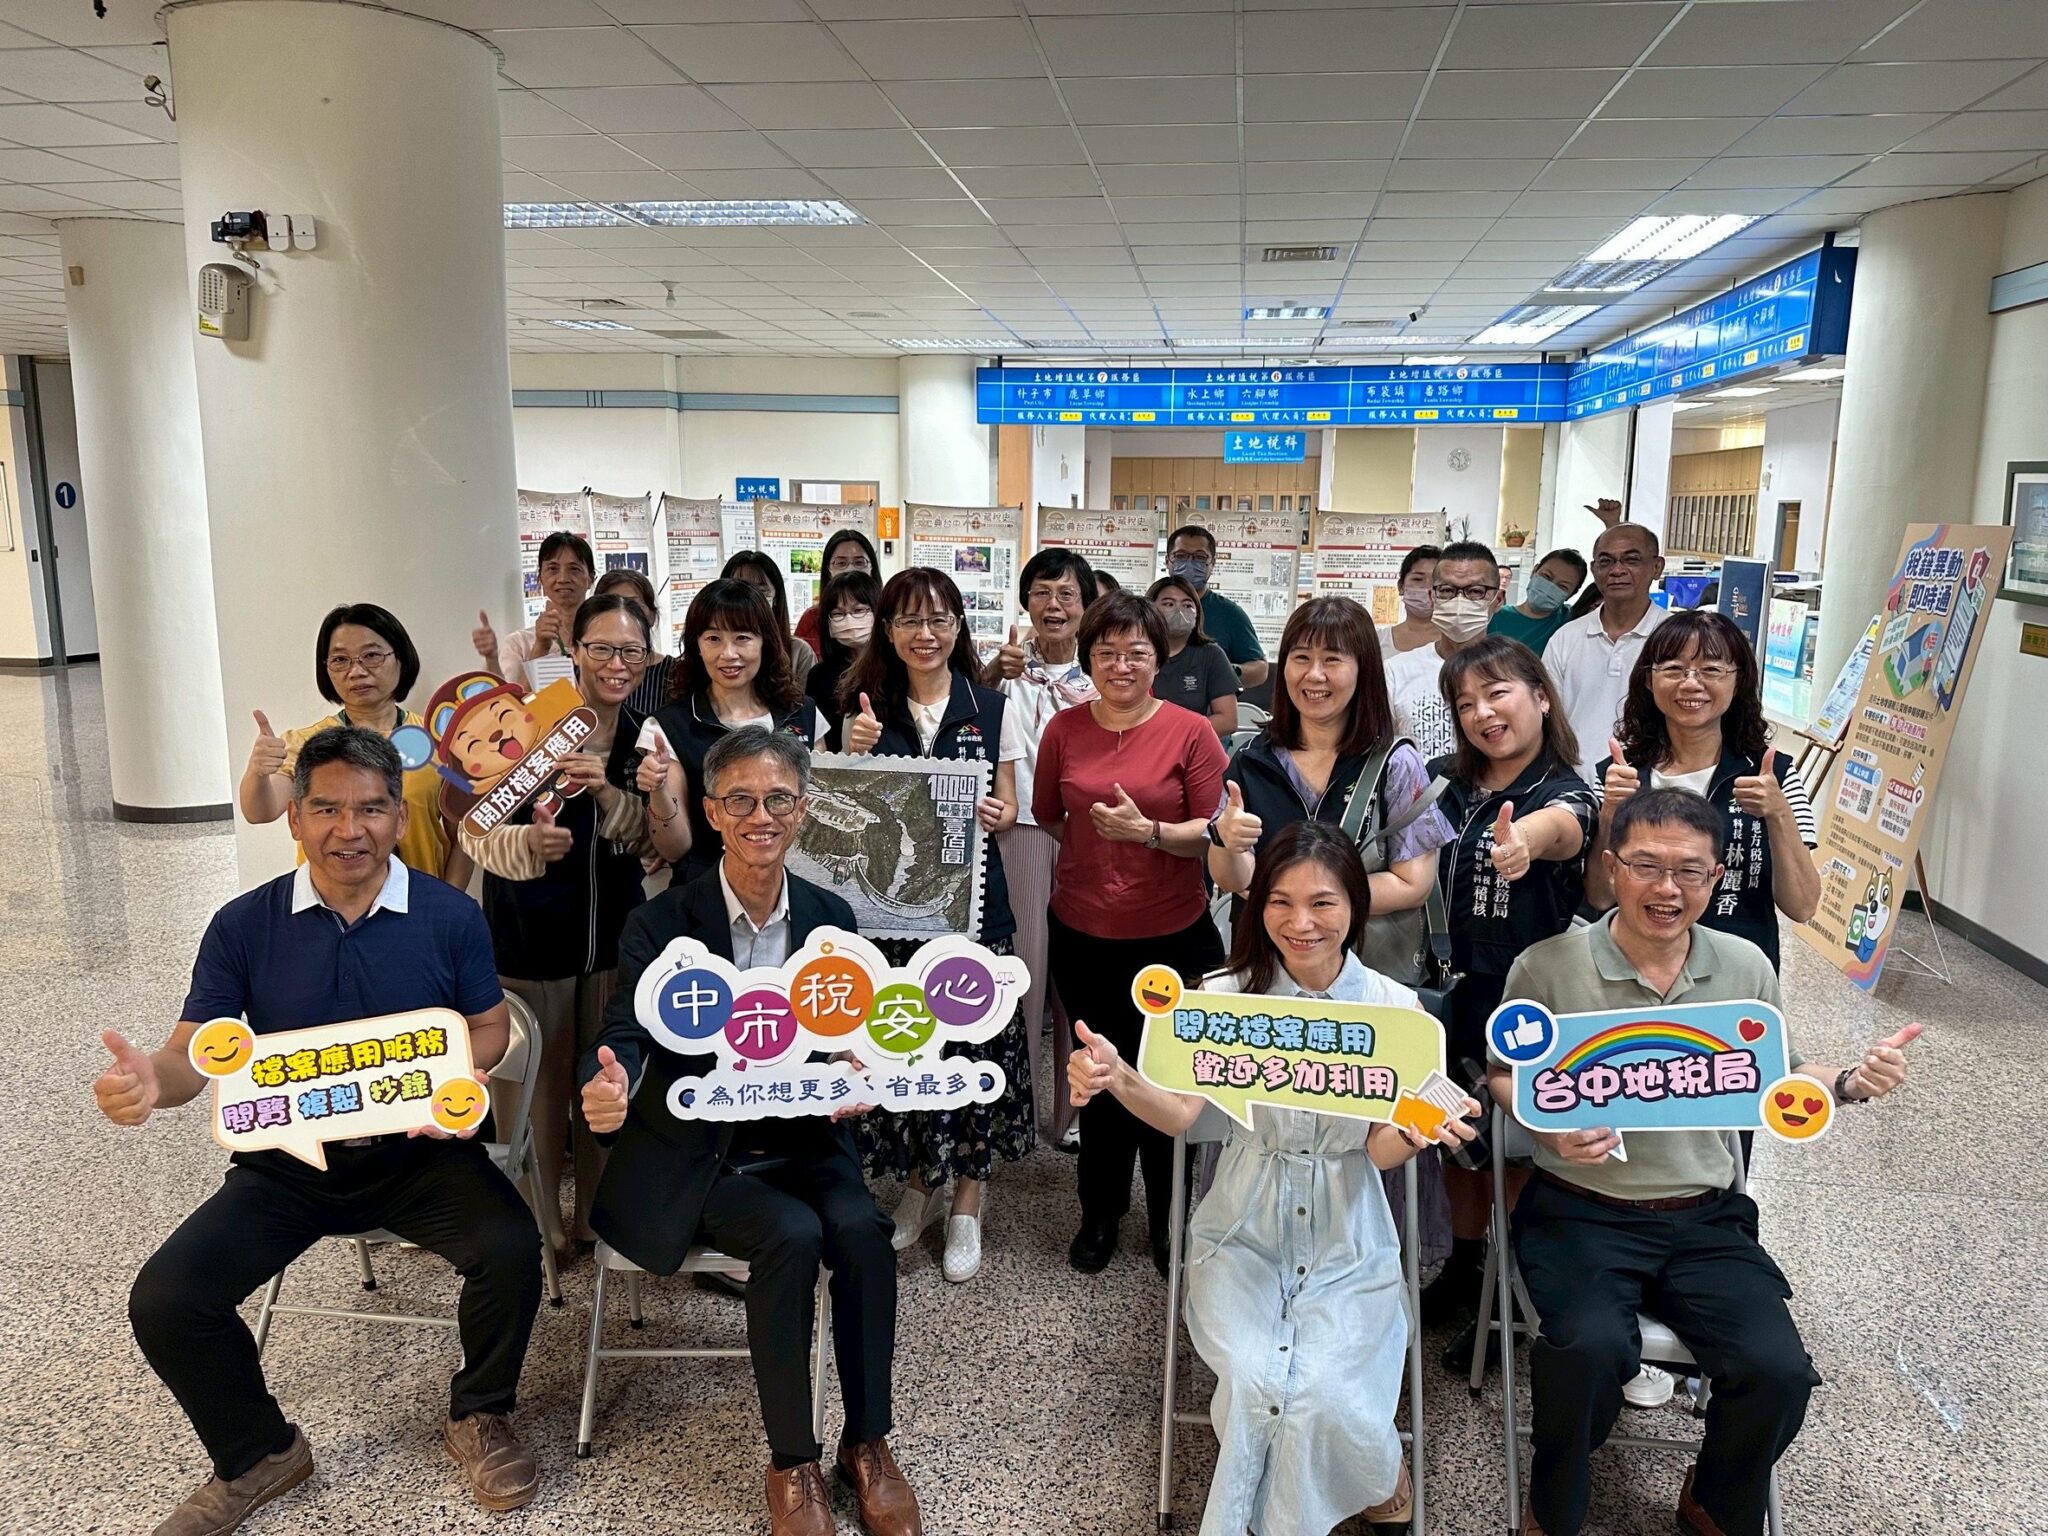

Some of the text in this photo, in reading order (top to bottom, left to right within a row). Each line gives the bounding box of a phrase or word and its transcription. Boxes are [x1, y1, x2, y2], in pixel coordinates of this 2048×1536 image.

[1017, 388, 1053, 399] 朴子市
[1068, 388, 1106, 399] 鹿草鄉
[1187, 388, 1225, 399] 水上鄉
[1367, 386, 1405, 398] 布袋鎮
[1424, 385, 1463, 397] 番路鄉
[1233, 435, 1297, 450] 土地稅科
[60, 485, 69, 506] 1
[739, 485, 776, 494] 土地稅科
[1905, 548, 1963, 580] 稅籍異動
[1907, 582, 1953, 615] 即時通
[471, 715, 591, 831] 開放檔案應用
[942, 818, 966, 864] 壹佰圓
[1733, 818, 1743, 839] 科長
[1748, 820, 1762, 889] 地方稅務局
[1491, 870, 1510, 918] 稅務局
[1716, 842, 1744, 916] 林麗香
[1472, 885, 1488, 917] 稽核
[672, 972, 987, 1049] 中市稅安心
[1174, 1009, 1376, 1057] 開放檔案應用
[252, 1027, 448, 1087] 檔案應用服務
[706, 1072, 969, 1107] 為你想更多、省最多
[1193, 1050, 1399, 1102] 歡迎多加利用
[1533, 1048, 1761, 1113] 台中地稅局
[222, 1070, 433, 1134] 閱覽 複製 抄錄
